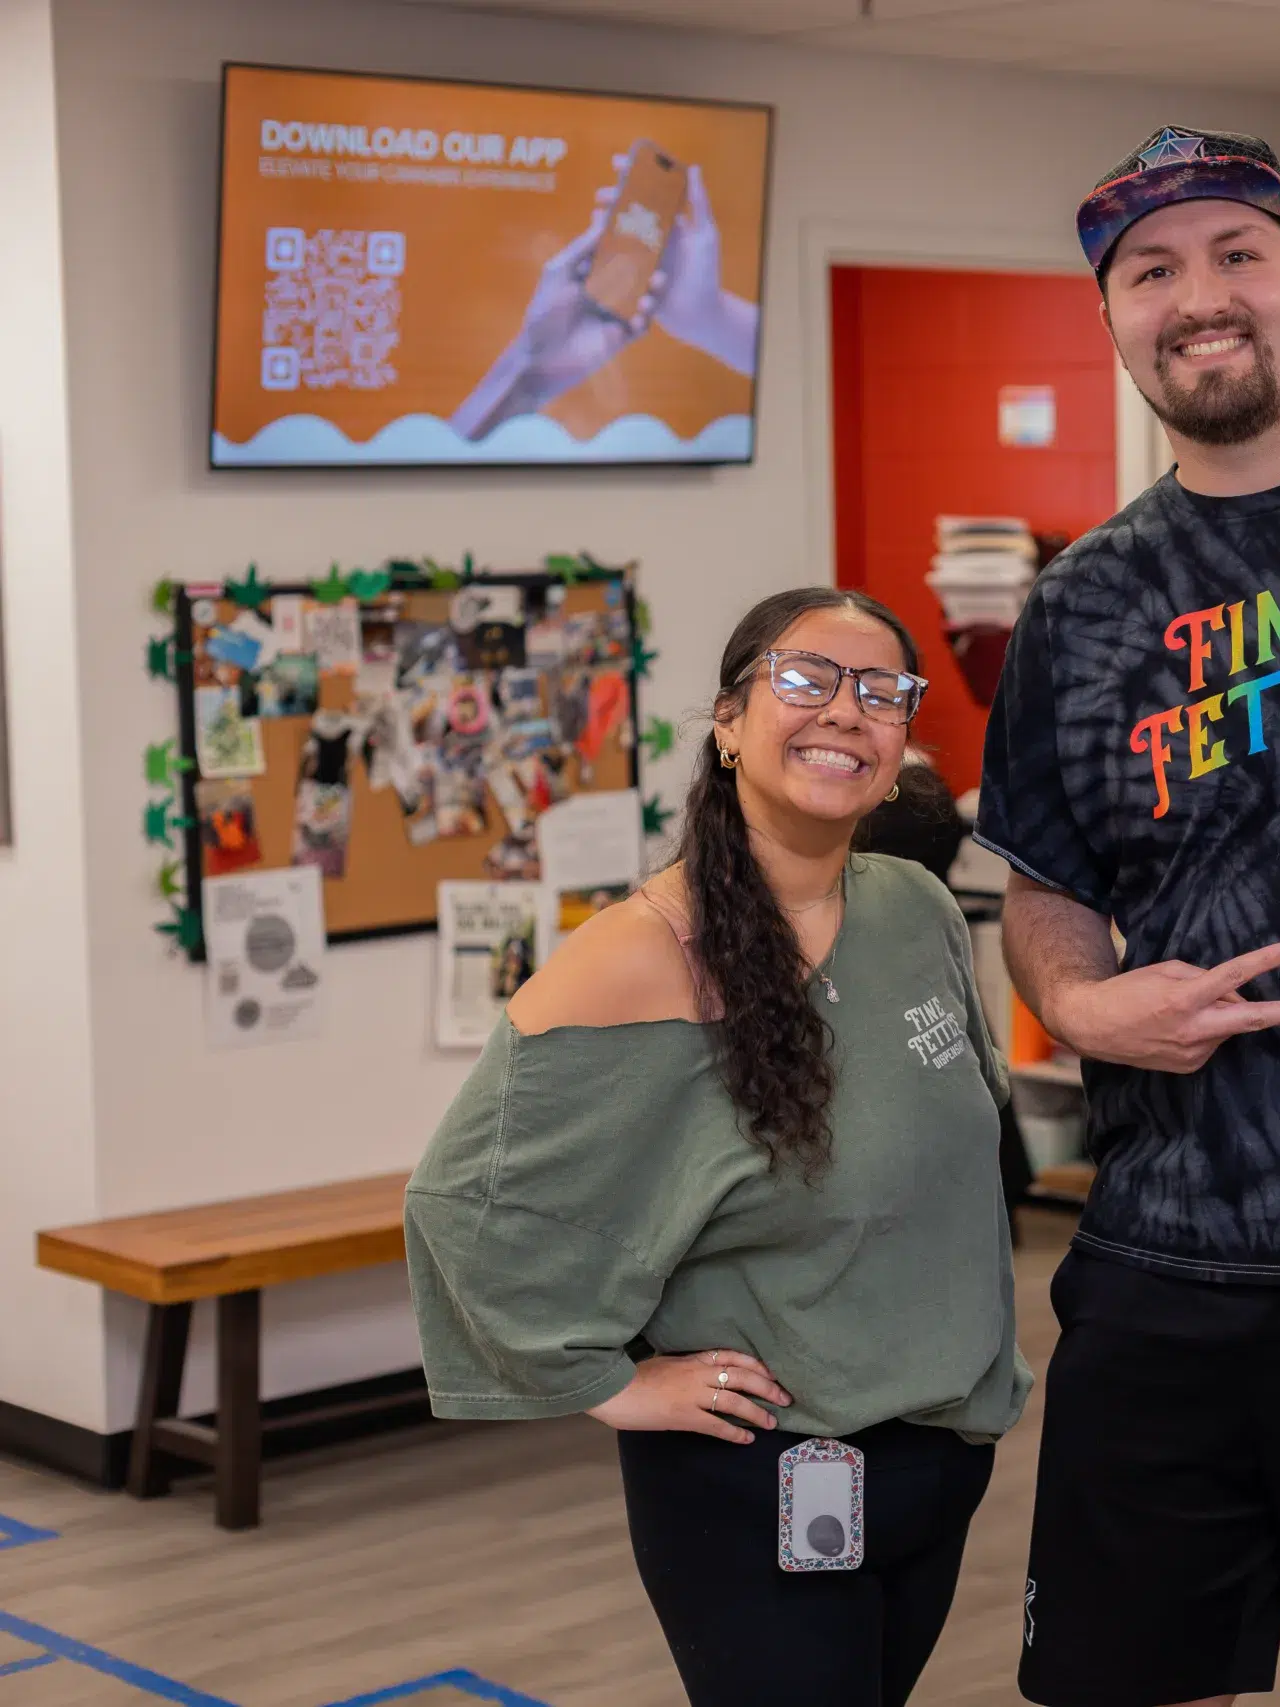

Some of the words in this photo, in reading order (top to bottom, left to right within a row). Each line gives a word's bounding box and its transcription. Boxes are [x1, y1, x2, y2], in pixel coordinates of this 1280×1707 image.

[260, 119, 437, 159] DOWNLOAD
[443, 131, 505, 165] OUR
[510, 136, 567, 166] APP
[904, 996, 946, 1032] FINE
